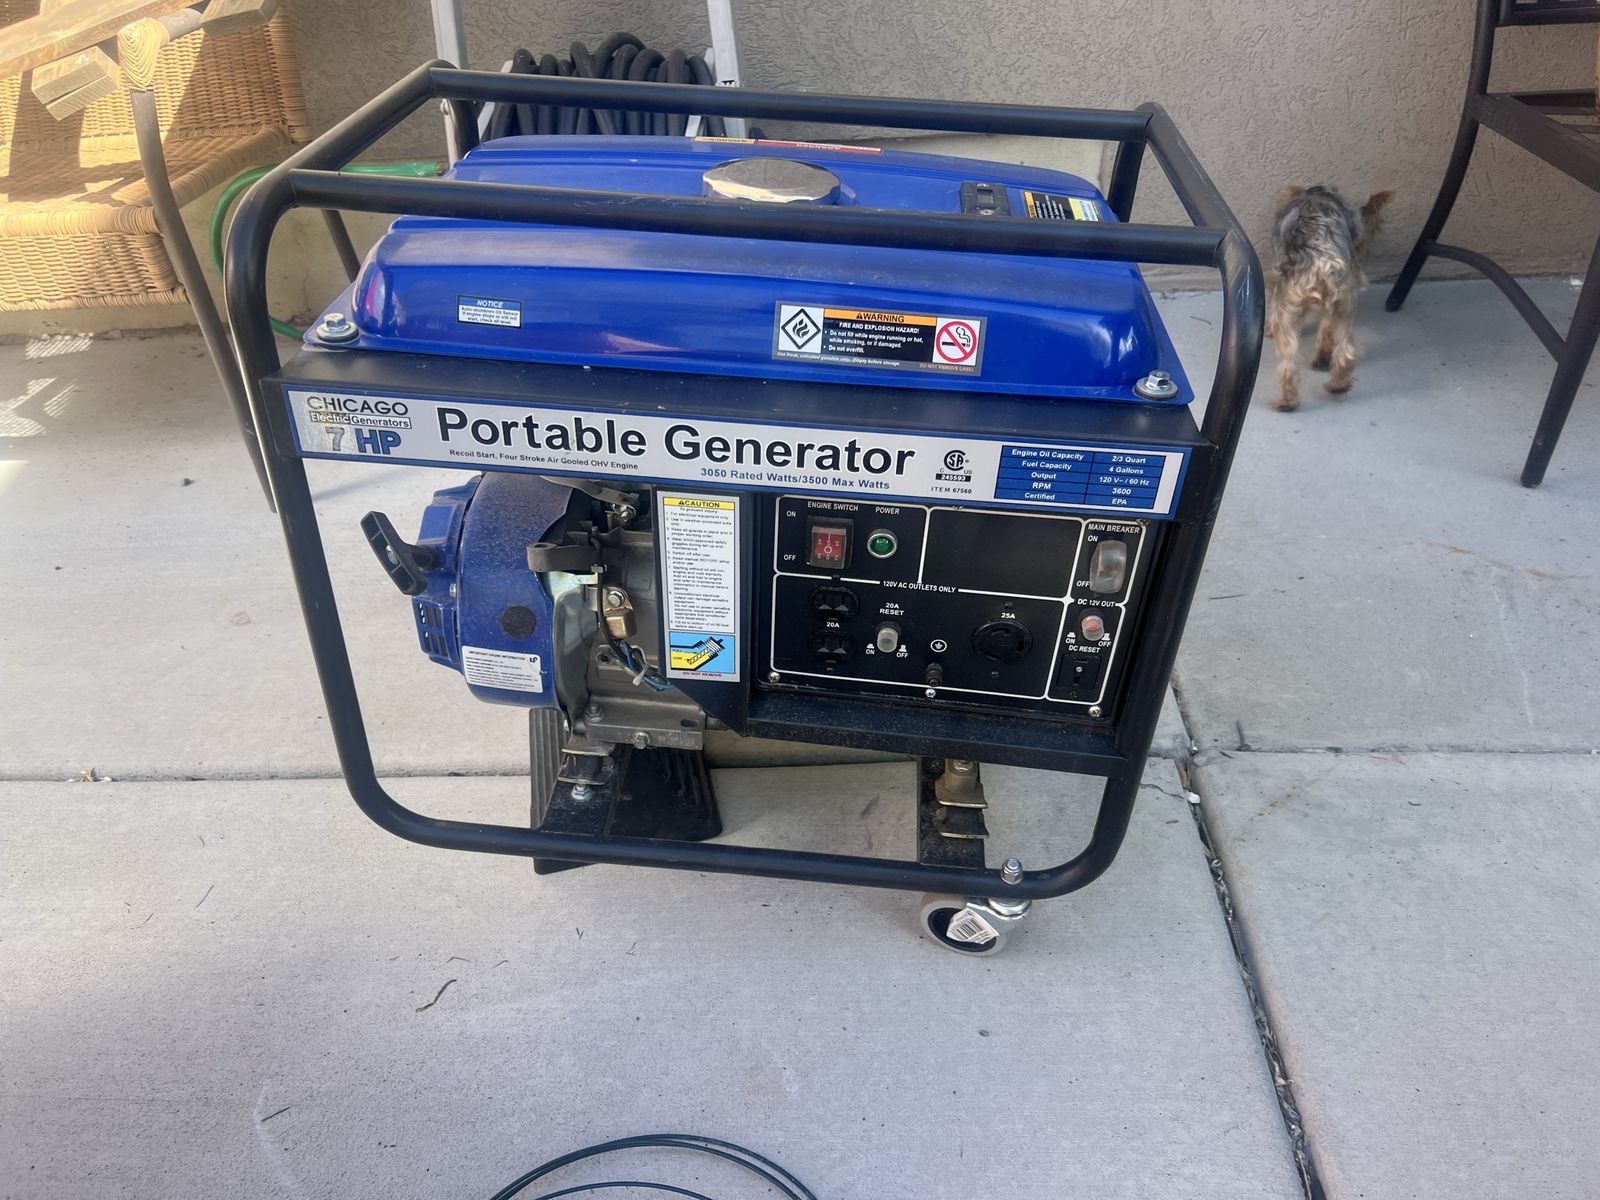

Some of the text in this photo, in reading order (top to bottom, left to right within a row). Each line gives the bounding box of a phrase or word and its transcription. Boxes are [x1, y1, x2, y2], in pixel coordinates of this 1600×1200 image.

[477, 299, 503, 308] NOTICE
[862, 313, 904, 323] WARNING
[307, 396, 408, 416] CHICAGO
[310, 412, 410, 428] Electric Generators
[325, 427, 402, 455] 7 HP
[436, 407, 915, 476] Portable Generator
[450, 449, 474, 457] Recoil
[476, 451, 498, 460] Start,
[500, 453, 518, 461] Four
[520, 454, 545, 463] Stroke
[611, 462, 638, 470] Engine
[1012, 449, 1084, 461] Engine Oil Capacity
[1112, 455, 1146, 464] 2/3 Quart
[1022, 460, 1072, 471] Fuel Capacity
[1031, 471, 1057, 480] Output
[1115, 467, 1144, 475] Gallons
[701, 468, 890, 490] 3050 Rated Watts/3500 Max Watts
[1099, 476, 1112, 484] 120
[931, 486, 972, 495] ITEM 67560
[1032, 482, 1051, 490] RPM
[1112, 487, 1132, 495] 3600
[1025, 492, 1055, 501] Certified
[685, 500, 719, 508] CAUTION
[808, 501, 858, 512] ENGINE SWITCH
[876, 507, 900, 515] POWER
[1088, 524, 1140, 533] MAIN BREAKER
[909, 582, 937, 591] OUTLETS
[939, 585, 956, 593] ONLY
